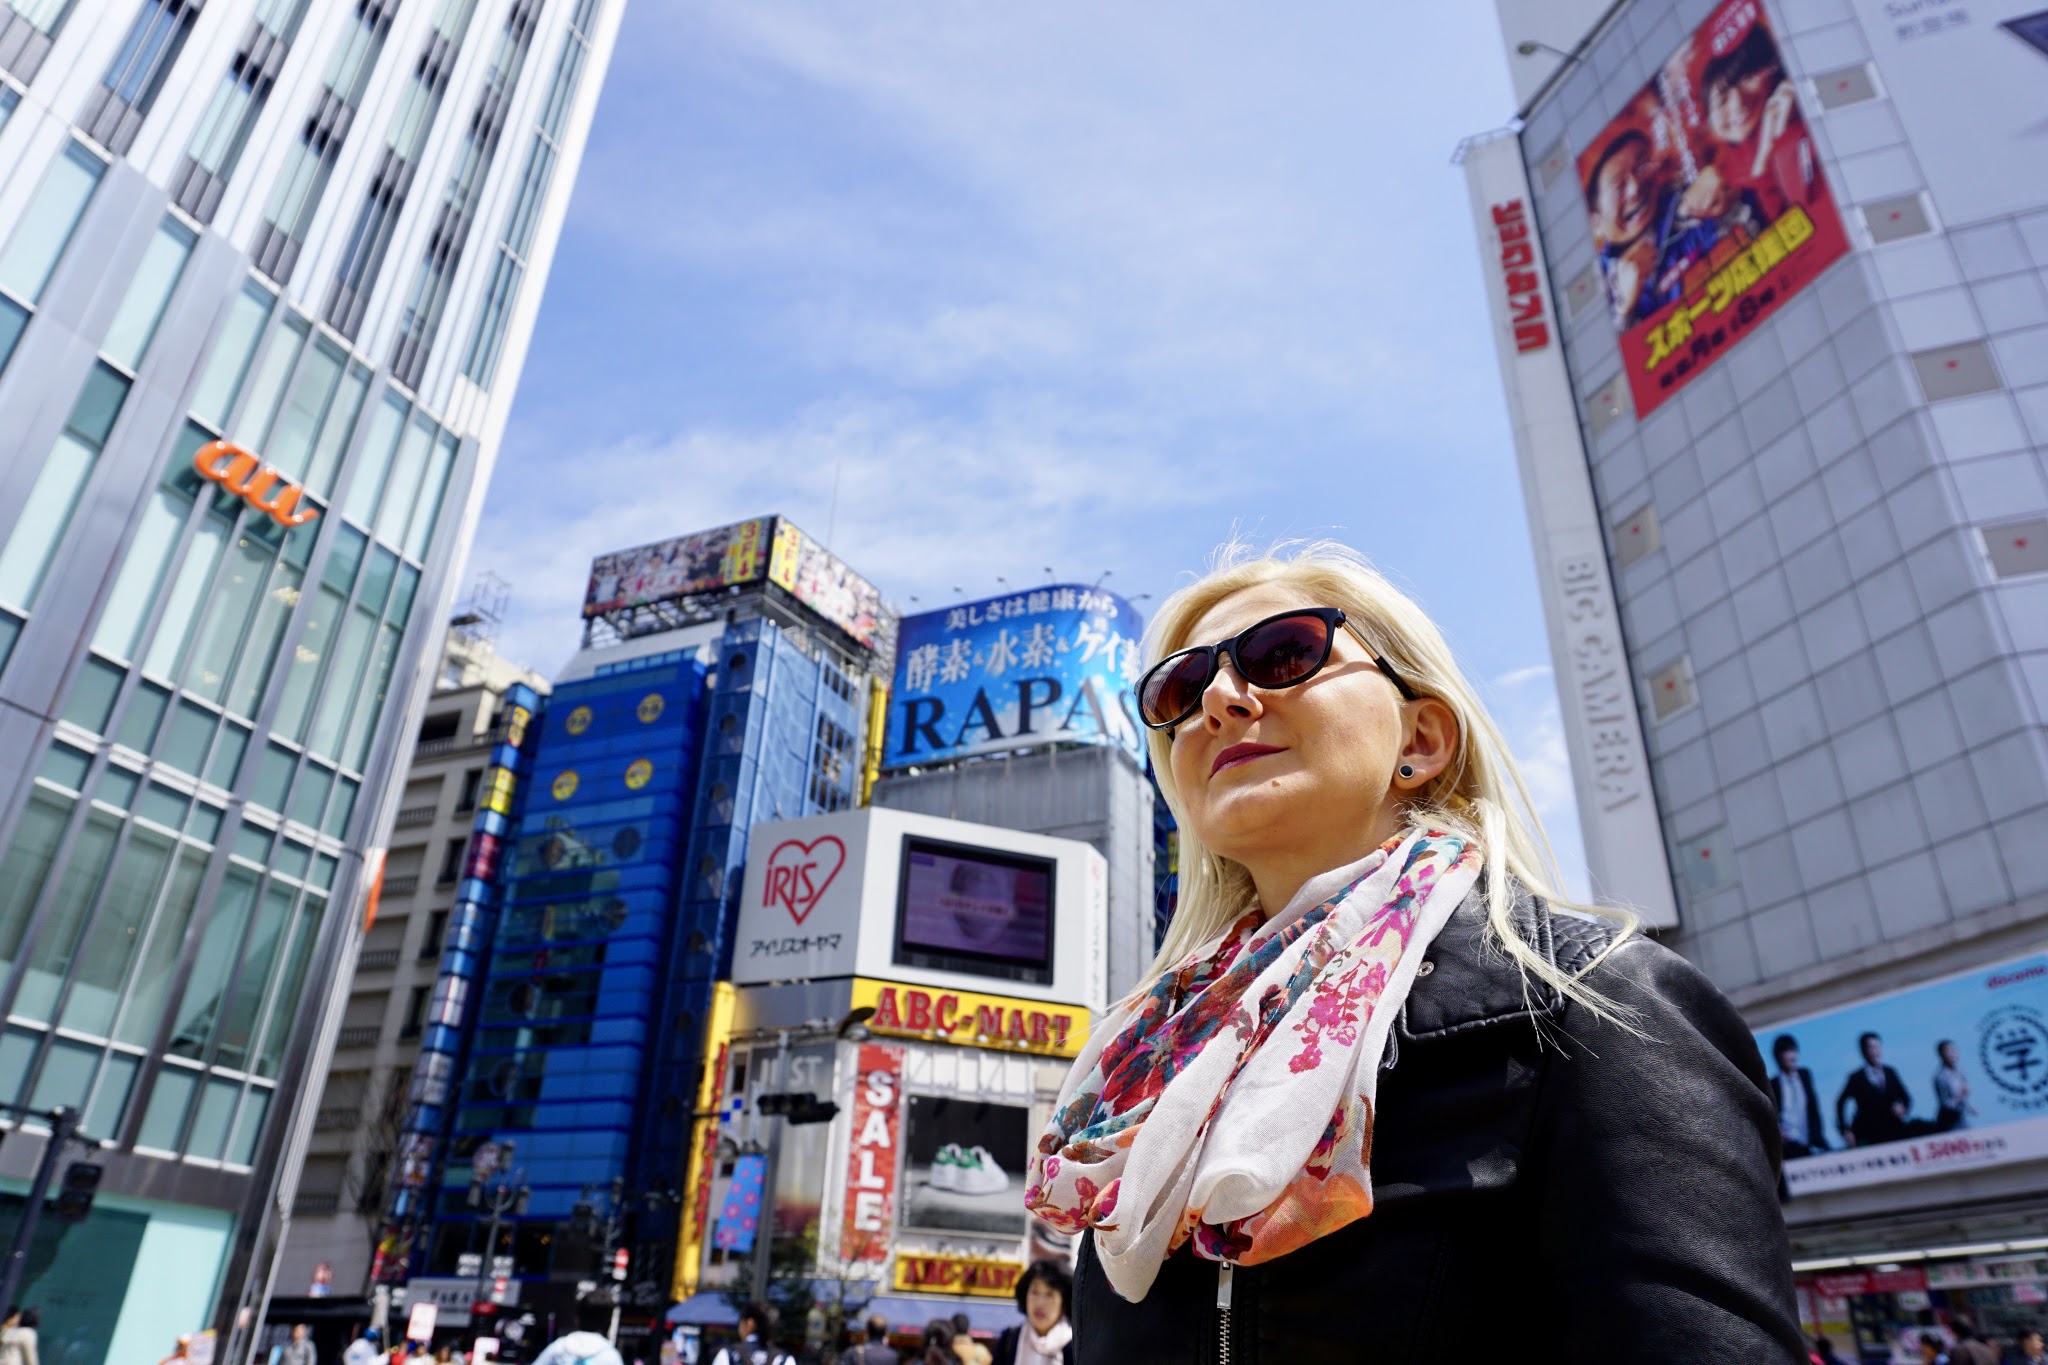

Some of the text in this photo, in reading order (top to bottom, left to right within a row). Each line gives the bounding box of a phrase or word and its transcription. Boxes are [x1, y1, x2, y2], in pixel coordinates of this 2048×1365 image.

[194, 440, 319, 527] au
[945, 588, 1118, 631] 美しさは健康から
[1560, 558, 1644, 813] BIC CAMERA
[749, 933, 842, 958] アイリスオーヤマ
[873, 987, 1072, 1047] ABC-MART
[854, 1069, 894, 1232] SALE
